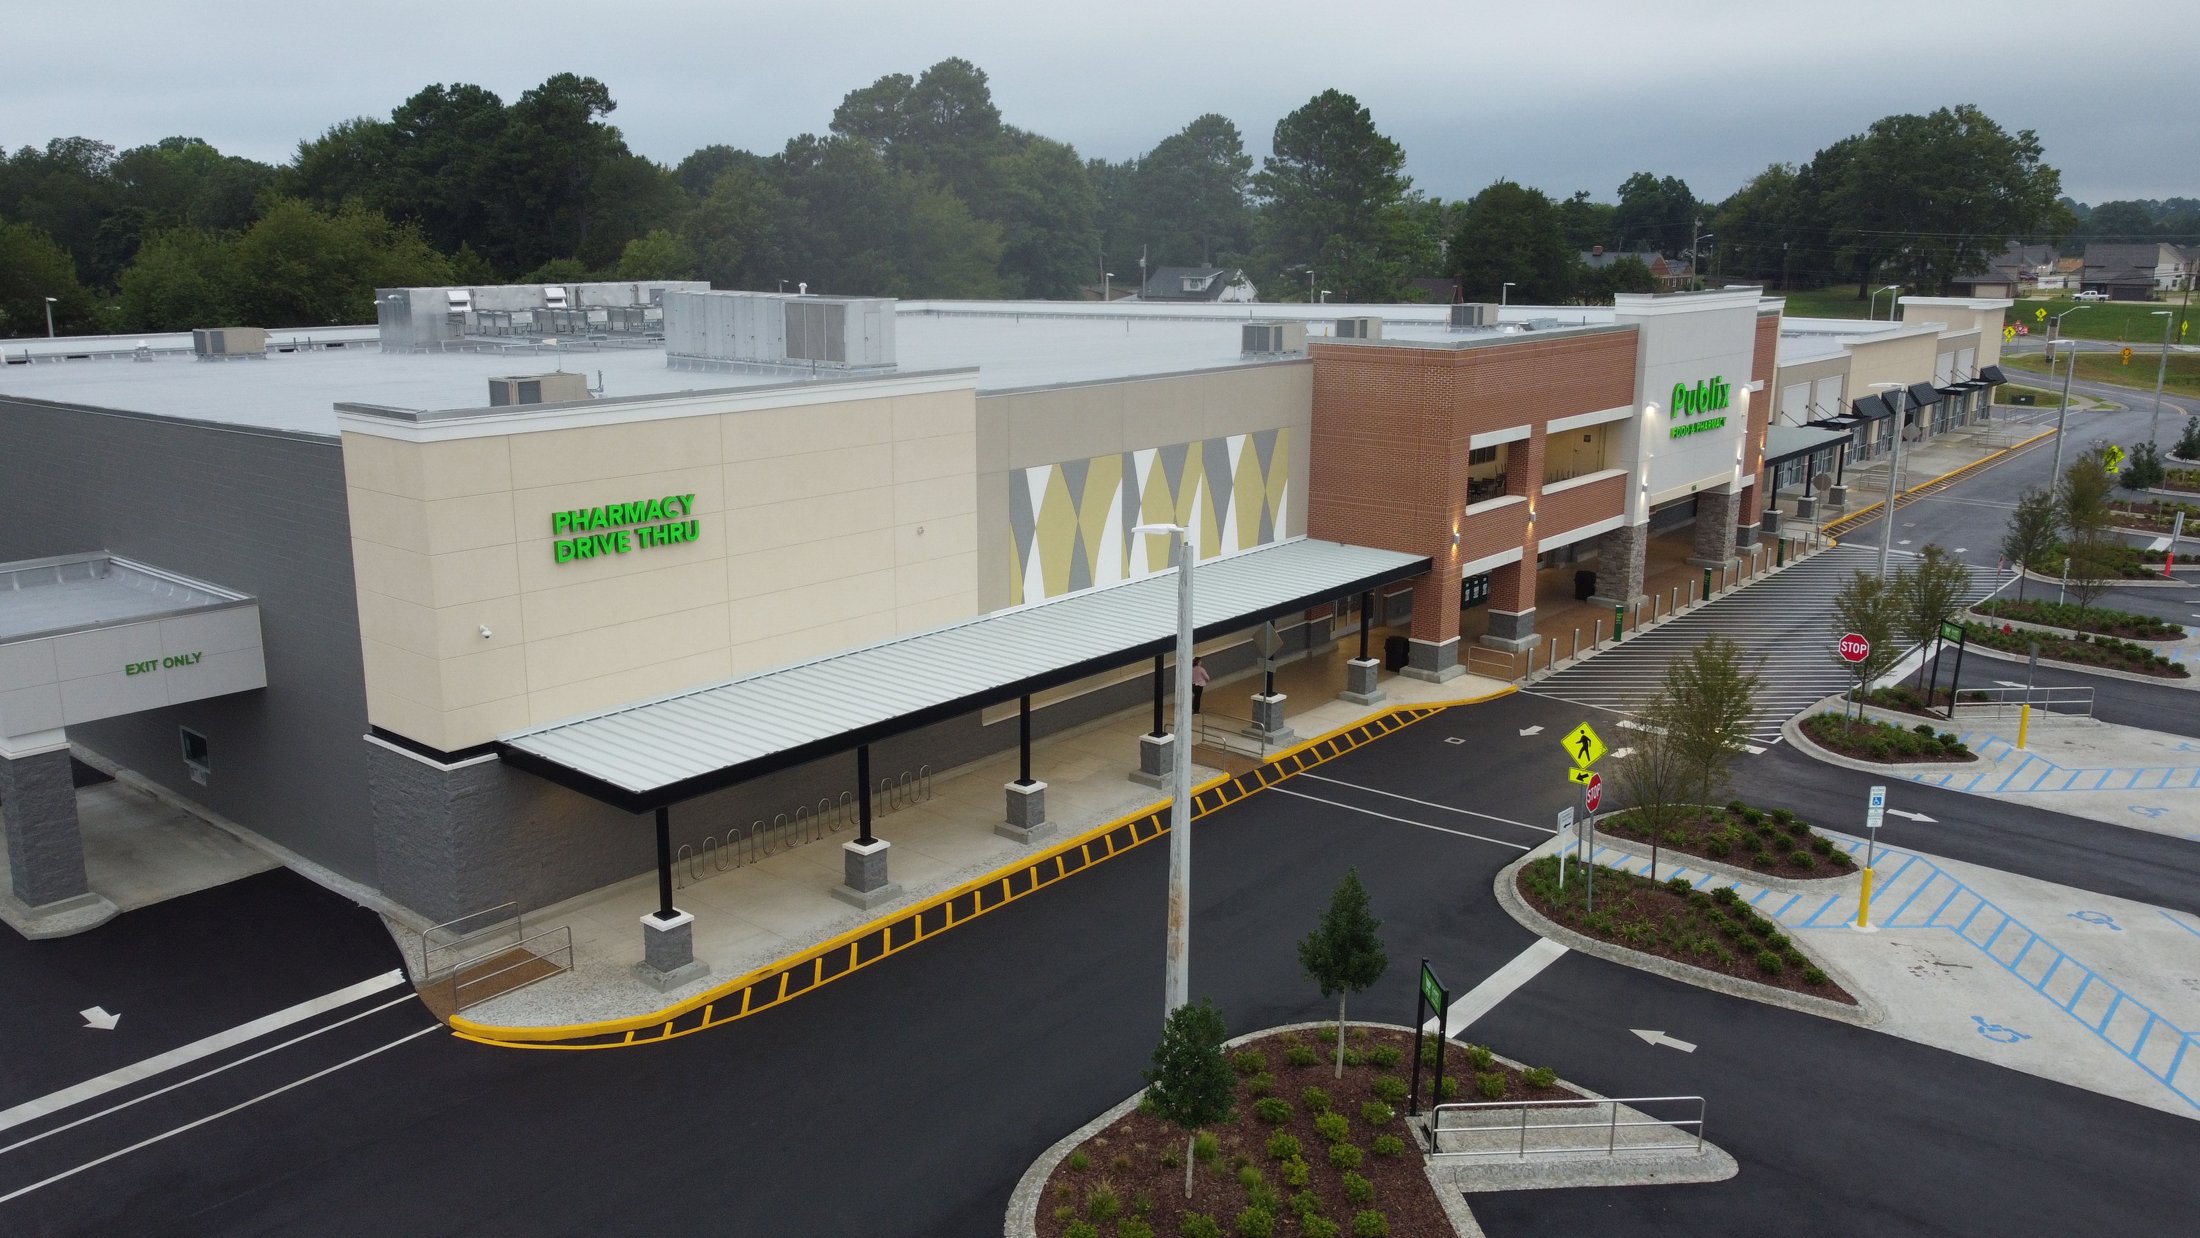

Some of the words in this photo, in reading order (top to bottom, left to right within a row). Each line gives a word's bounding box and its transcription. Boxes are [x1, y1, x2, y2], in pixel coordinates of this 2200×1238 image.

[1671, 376, 1731, 420] Publix
[1670, 425, 1690, 439] FOOD
[552, 494, 695, 535] PHARMACY
[554, 530, 632, 564] DRIVE
[634, 520, 700, 549] THRU
[1841, 641, 1867, 655] STOP
[125, 659, 158, 676] EXIT
[163, 652, 202, 668] ONLY
[1587, 783, 1601, 803] STOP
